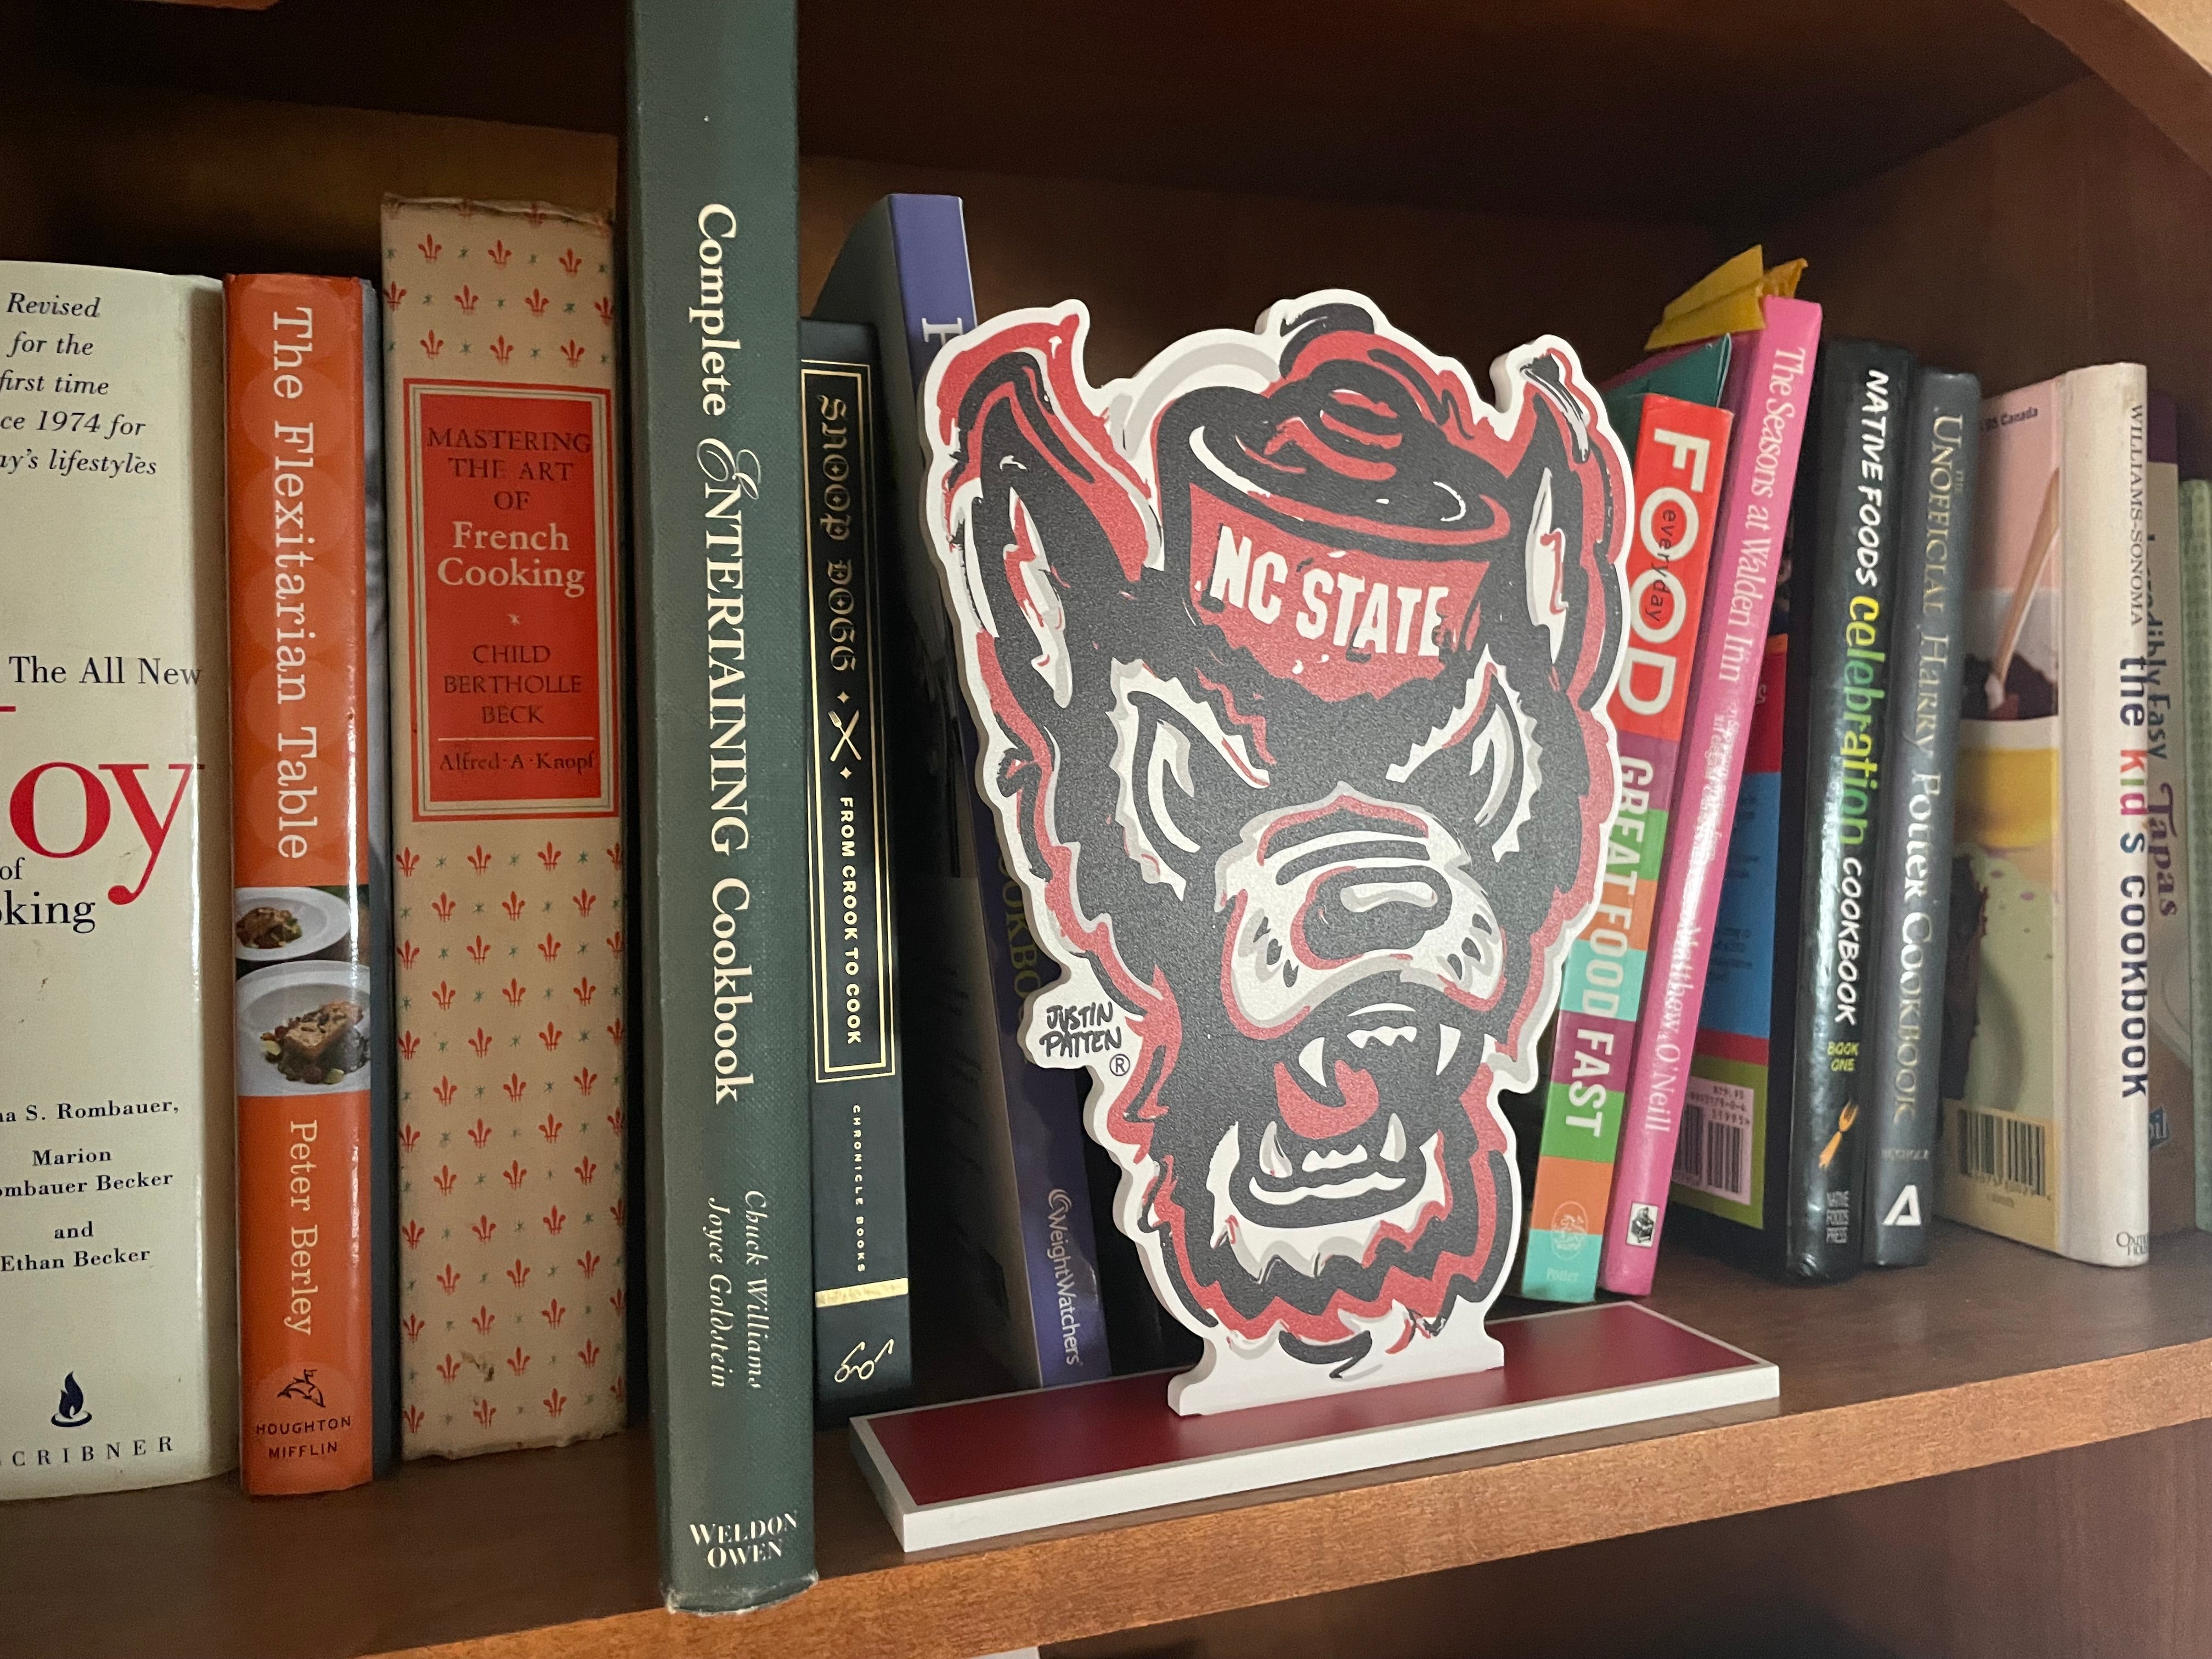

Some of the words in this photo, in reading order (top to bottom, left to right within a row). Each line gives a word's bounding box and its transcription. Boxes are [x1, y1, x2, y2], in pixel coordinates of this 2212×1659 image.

[6, 292, 101, 318] Revised
[688, 202, 742, 416] Complete
[7, 331, 47, 357] for
[57, 333, 93, 355] the
[272, 306, 313, 399] The
[1768, 347, 1806, 396] The
[0, 369, 44, 392] first
[55, 374, 109, 395] time
[36, 410, 100, 433] 1974
[104, 414, 145, 439] for
[427, 427, 591, 453] MASTERING
[1751, 398, 1795, 498] Seasons
[1861, 369, 1889, 481] NATIVE
[49, 449, 156, 478] lifestyles
[448, 457, 505, 479] THE
[519, 461, 573, 482] ART
[816, 394, 852, 541] SNOOP
[494, 491, 531, 510] OF
[1745, 505, 1769, 529] at
[1922, 414, 1963, 614] UNOFFICIAL
[2129, 404, 2142, 627] WILLIAMS-SONOMA
[274, 421, 317, 705] Flexitarian
[453, 521, 570, 551] French
[1645, 509, 1677, 622] everyday
[1855, 484, 1882, 588] FOODS
[438, 557, 585, 598] Cooking
[1210, 525, 1288, 624] NC
[1296, 568, 1449, 656] STATE
[1618, 428, 1710, 716] FOOD
[1728, 538, 1773, 627] Walden
[696, 437, 762, 857] ENTERTAINING
[827, 558, 856, 672] DOGG
[9, 656, 66, 684] The
[79, 657, 126, 684] All
[138, 658, 201, 685] New
[444, 675, 582, 693] BERTHOLLE
[473, 645, 550, 663] CHILD
[1718, 633, 1753, 682] Inn
[482, 706, 544, 724] BECK
[1840, 595, 1886, 845] Celebration
[1915, 634, 1949, 757] HARRY
[2120, 656, 2148, 726] the
[0, 706, 205, 905] oy
[276, 726, 318, 859] Table
[839, 796, 855, 857] FROM
[1606, 756, 1654, 896] GREAT
[0, 857, 25, 880] of
[1905, 770, 1941, 900] POTTER
[2148, 782, 2178, 917] Tapas
[0, 890, 96, 934] king
[842, 864, 859, 941] CROOK
[844, 946, 859, 975] TO
[1581, 904, 1632, 1019] FOOD
[1835, 856, 1862, 1026] COOKBOOK
[712, 876, 755, 1105] Cookbook
[846, 983, 861, 1045] COOK
[1046, 1002, 1113, 1031] JUSTIN
[1892, 911, 1932, 1125] COOKBOOK
[2120, 874, 2149, 1098] cookbook
[1039, 1026, 1121, 1058] PATTEN
[1827, 1042, 1859, 1056] BOOK
[1831, 1058, 1855, 1071] ONE
[26, 1104, 46, 1121] S.
[57, 1100, 179, 1120] Rombauer,
[1565, 1029, 1614, 1138] FAST
[1645, 1045, 1680, 1132] O'Neill
[32, 1148, 112, 1166] Marion
[97, 1172, 173, 1191] Becker
[290, 1119, 318, 1212] Peter
[853, 1104, 864, 1206] CHRONICLE
[0, 1255, 65, 1271] Ethan
[74, 1248, 150, 1267] Becker
[54, 1221, 94, 1239] and
[702, 1197, 730, 1263] Joyce
[744, 1190, 768, 1265] Chuck
[856, 1216, 865, 1272] BOOKS
[284, 1223, 318, 1335] Berley
[1047, 1209, 1079, 1366] WeightWatchers
[709, 1274, 733, 1389] Goldstein
[746, 1278, 770, 1389] Williams
[0, 1435, 173, 1466] CRIBNER
[255, 1415, 351, 1435] HOUGHTON
[268, 1441, 338, 1459] MIFFLIN
[690, 1510, 798, 1545] WELDON
[707, 1538, 782, 1569] OWEN
